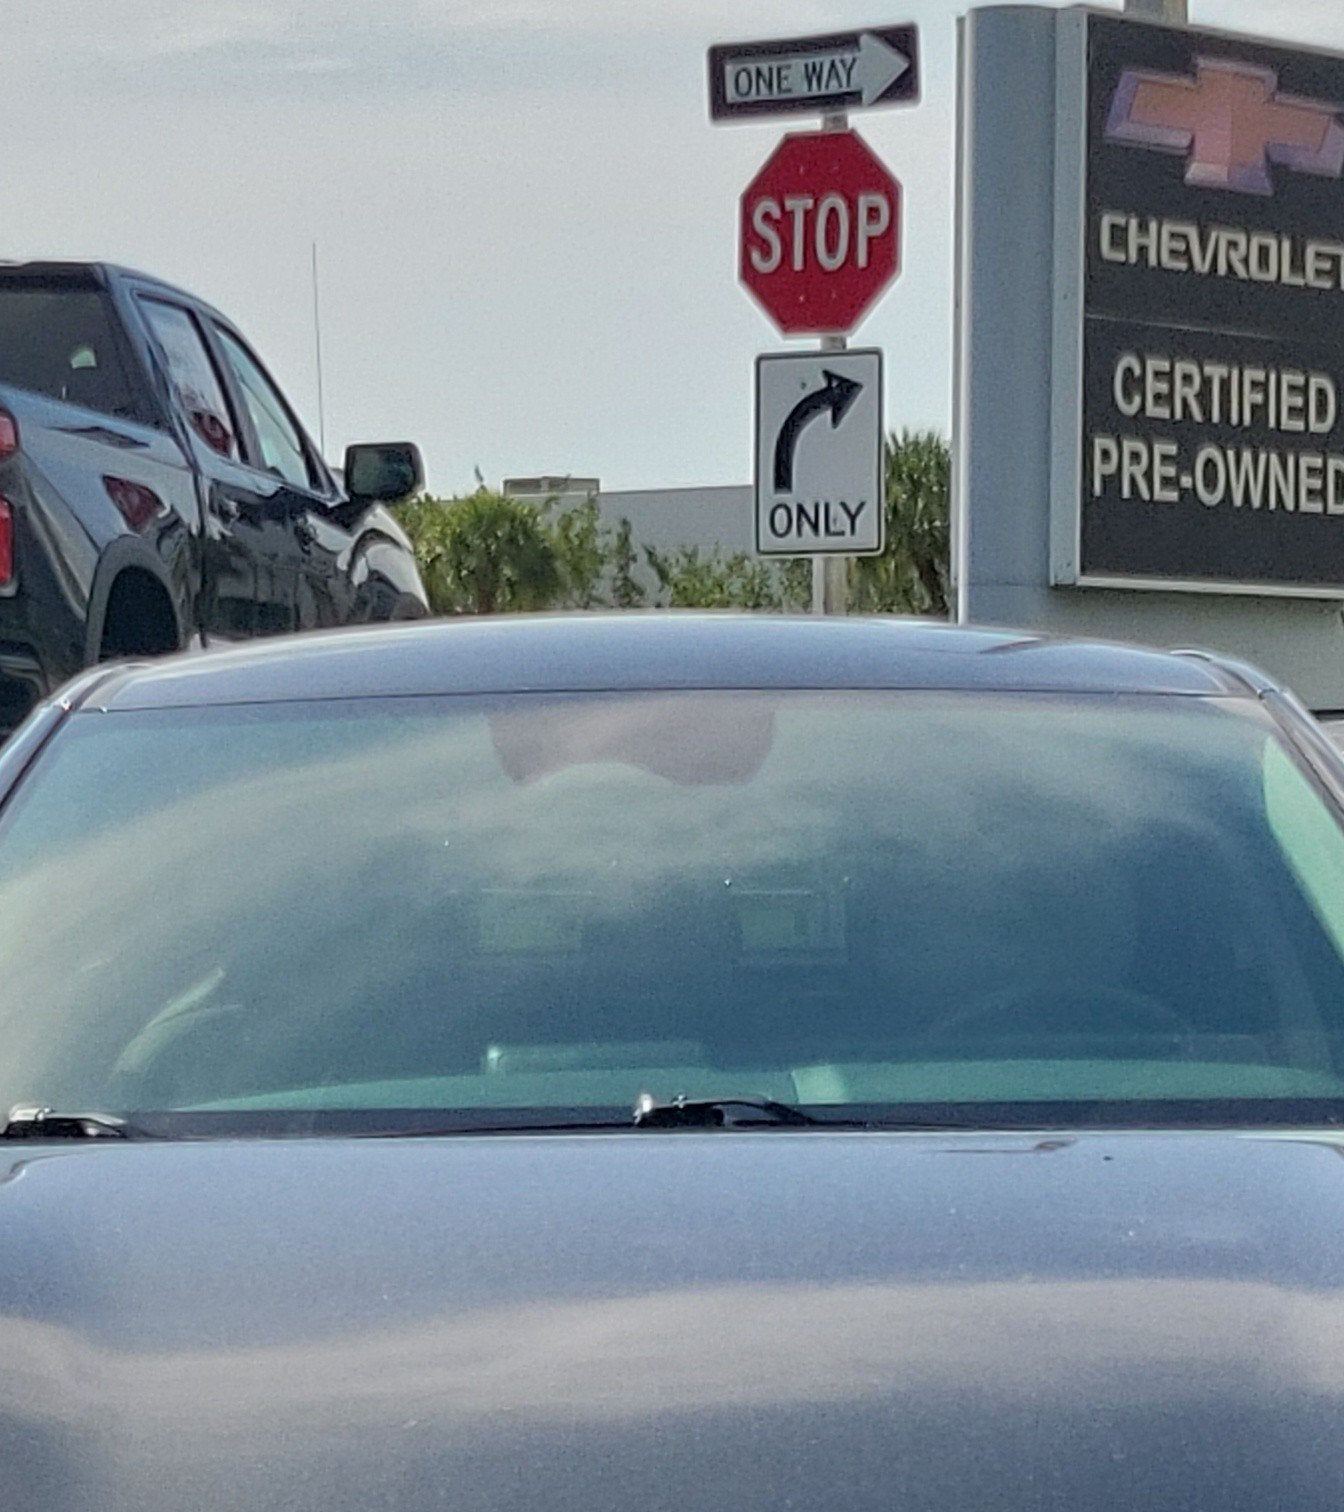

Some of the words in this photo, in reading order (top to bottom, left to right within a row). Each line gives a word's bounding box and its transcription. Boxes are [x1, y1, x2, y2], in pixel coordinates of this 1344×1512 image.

[733, 64, 791, 97] ONE
[802, 57, 858, 93] WAY
[751, 194, 891, 273] STOP
[1113, 352, 1336, 434] CERTIFIED
[769, 502, 866, 538] ONLY
